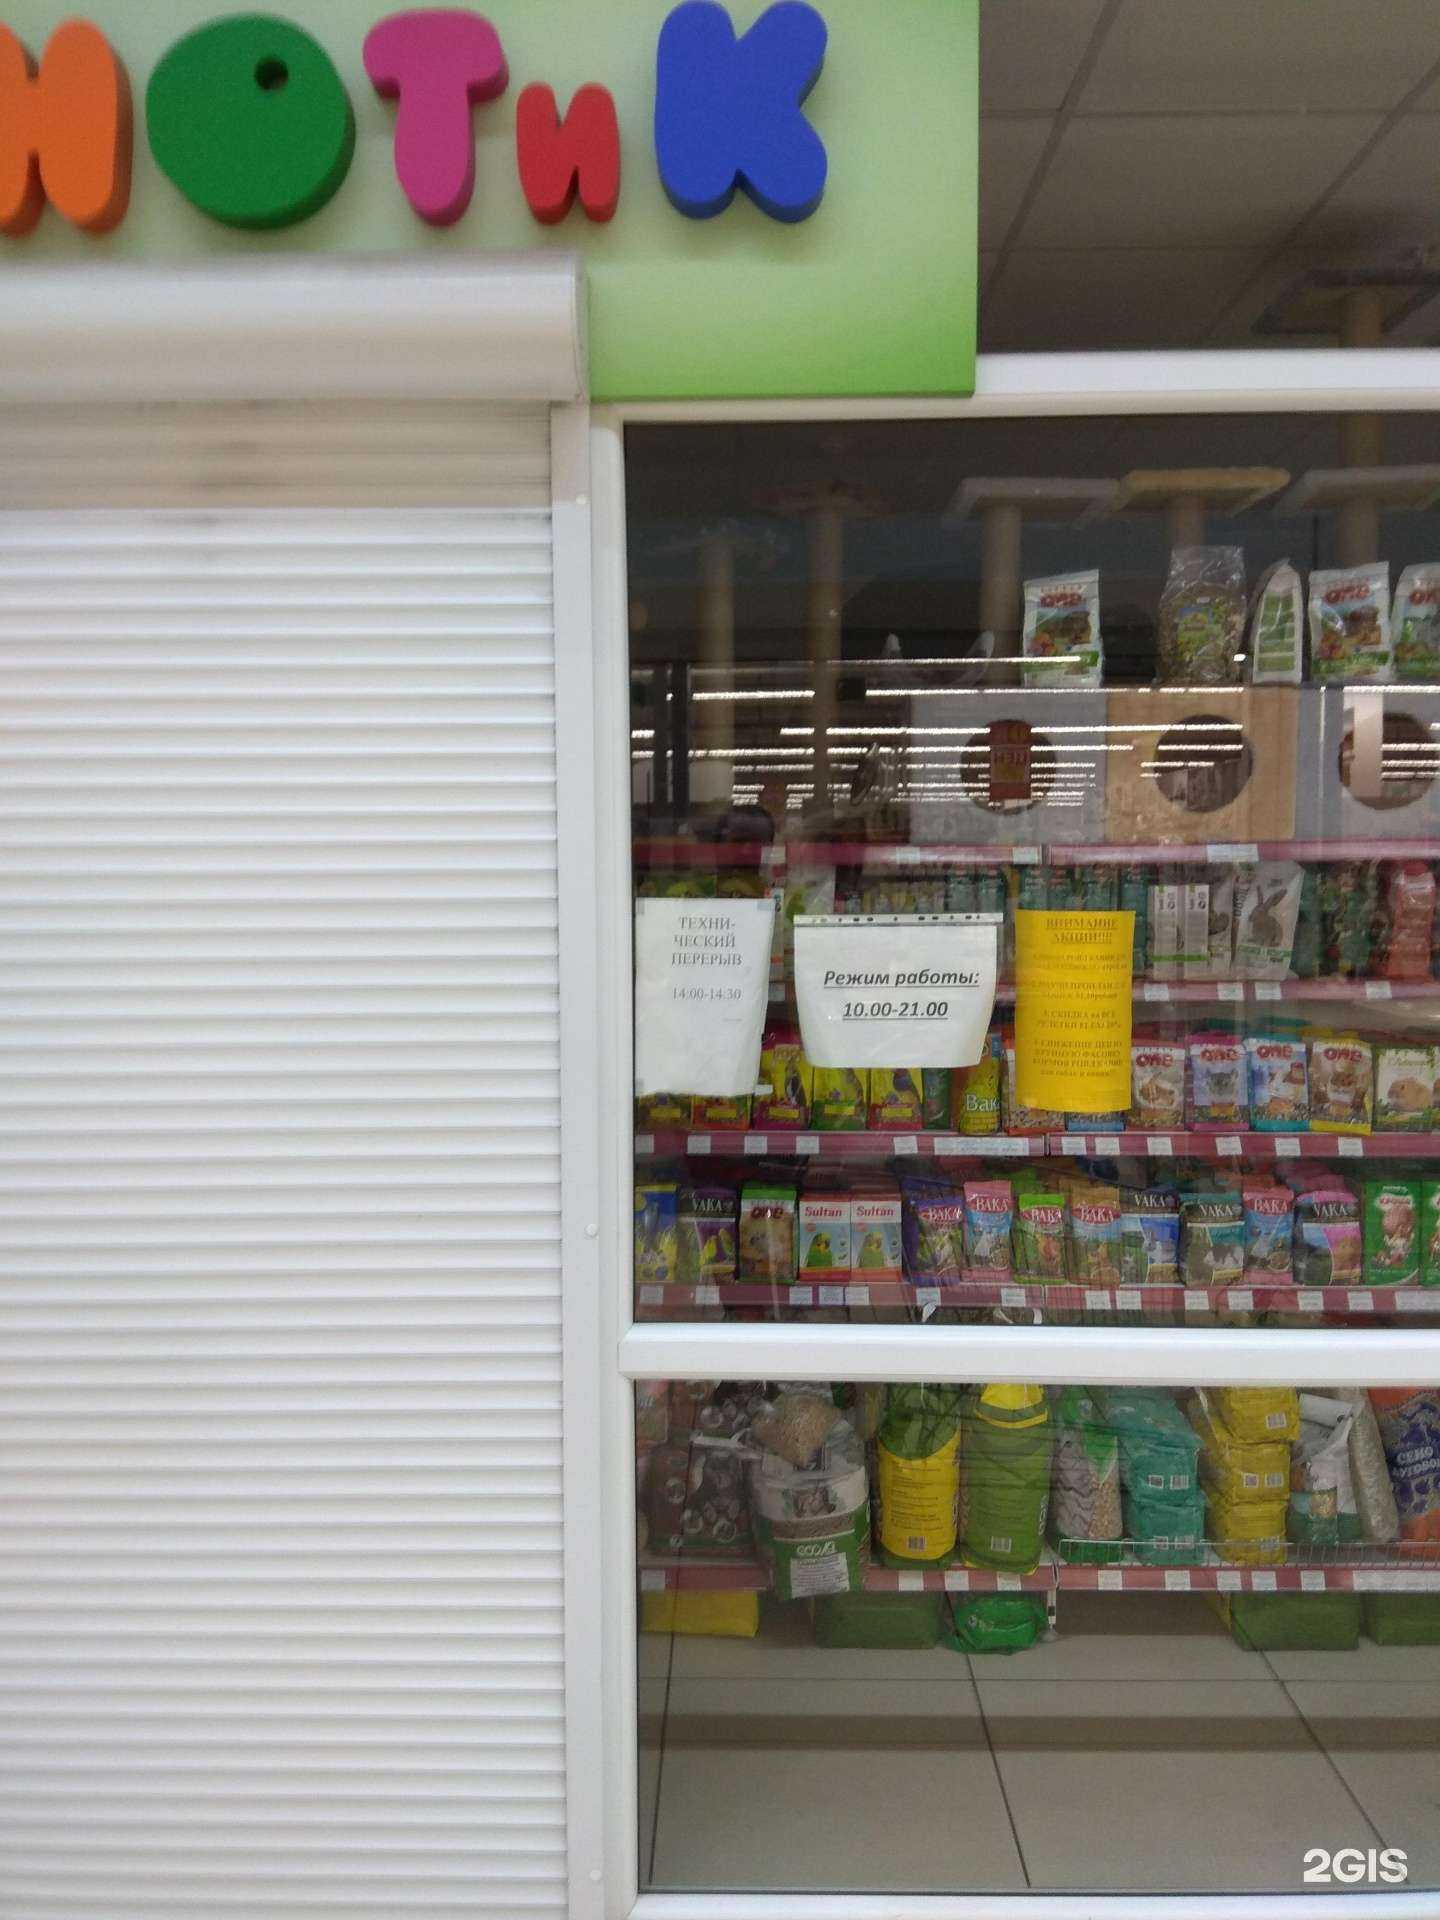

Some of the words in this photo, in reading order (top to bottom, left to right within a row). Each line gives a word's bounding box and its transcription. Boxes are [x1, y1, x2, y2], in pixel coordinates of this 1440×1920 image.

[679, 916, 736, 930] ТЕХНИ-
[673, 931, 736, 948] ЧЕСКИЙ
[671, 952, 742, 966] ПЕРЕРЫВ
[823, 970, 890, 986] Режим
[894, 968, 980, 987] работы:
[672, 987, 742, 1000] 14:00-14:30
[842, 1001, 949, 1018] 10.00-21.00
[1134, 1192, 1166, 1208] VAKA
[805, 1205, 842, 1218] Sultan
[856, 1205, 894, 1217] Sultan
[1200, 1203, 1233, 1217] VAKA
[1313, 1202, 1347, 1217] VAKA
